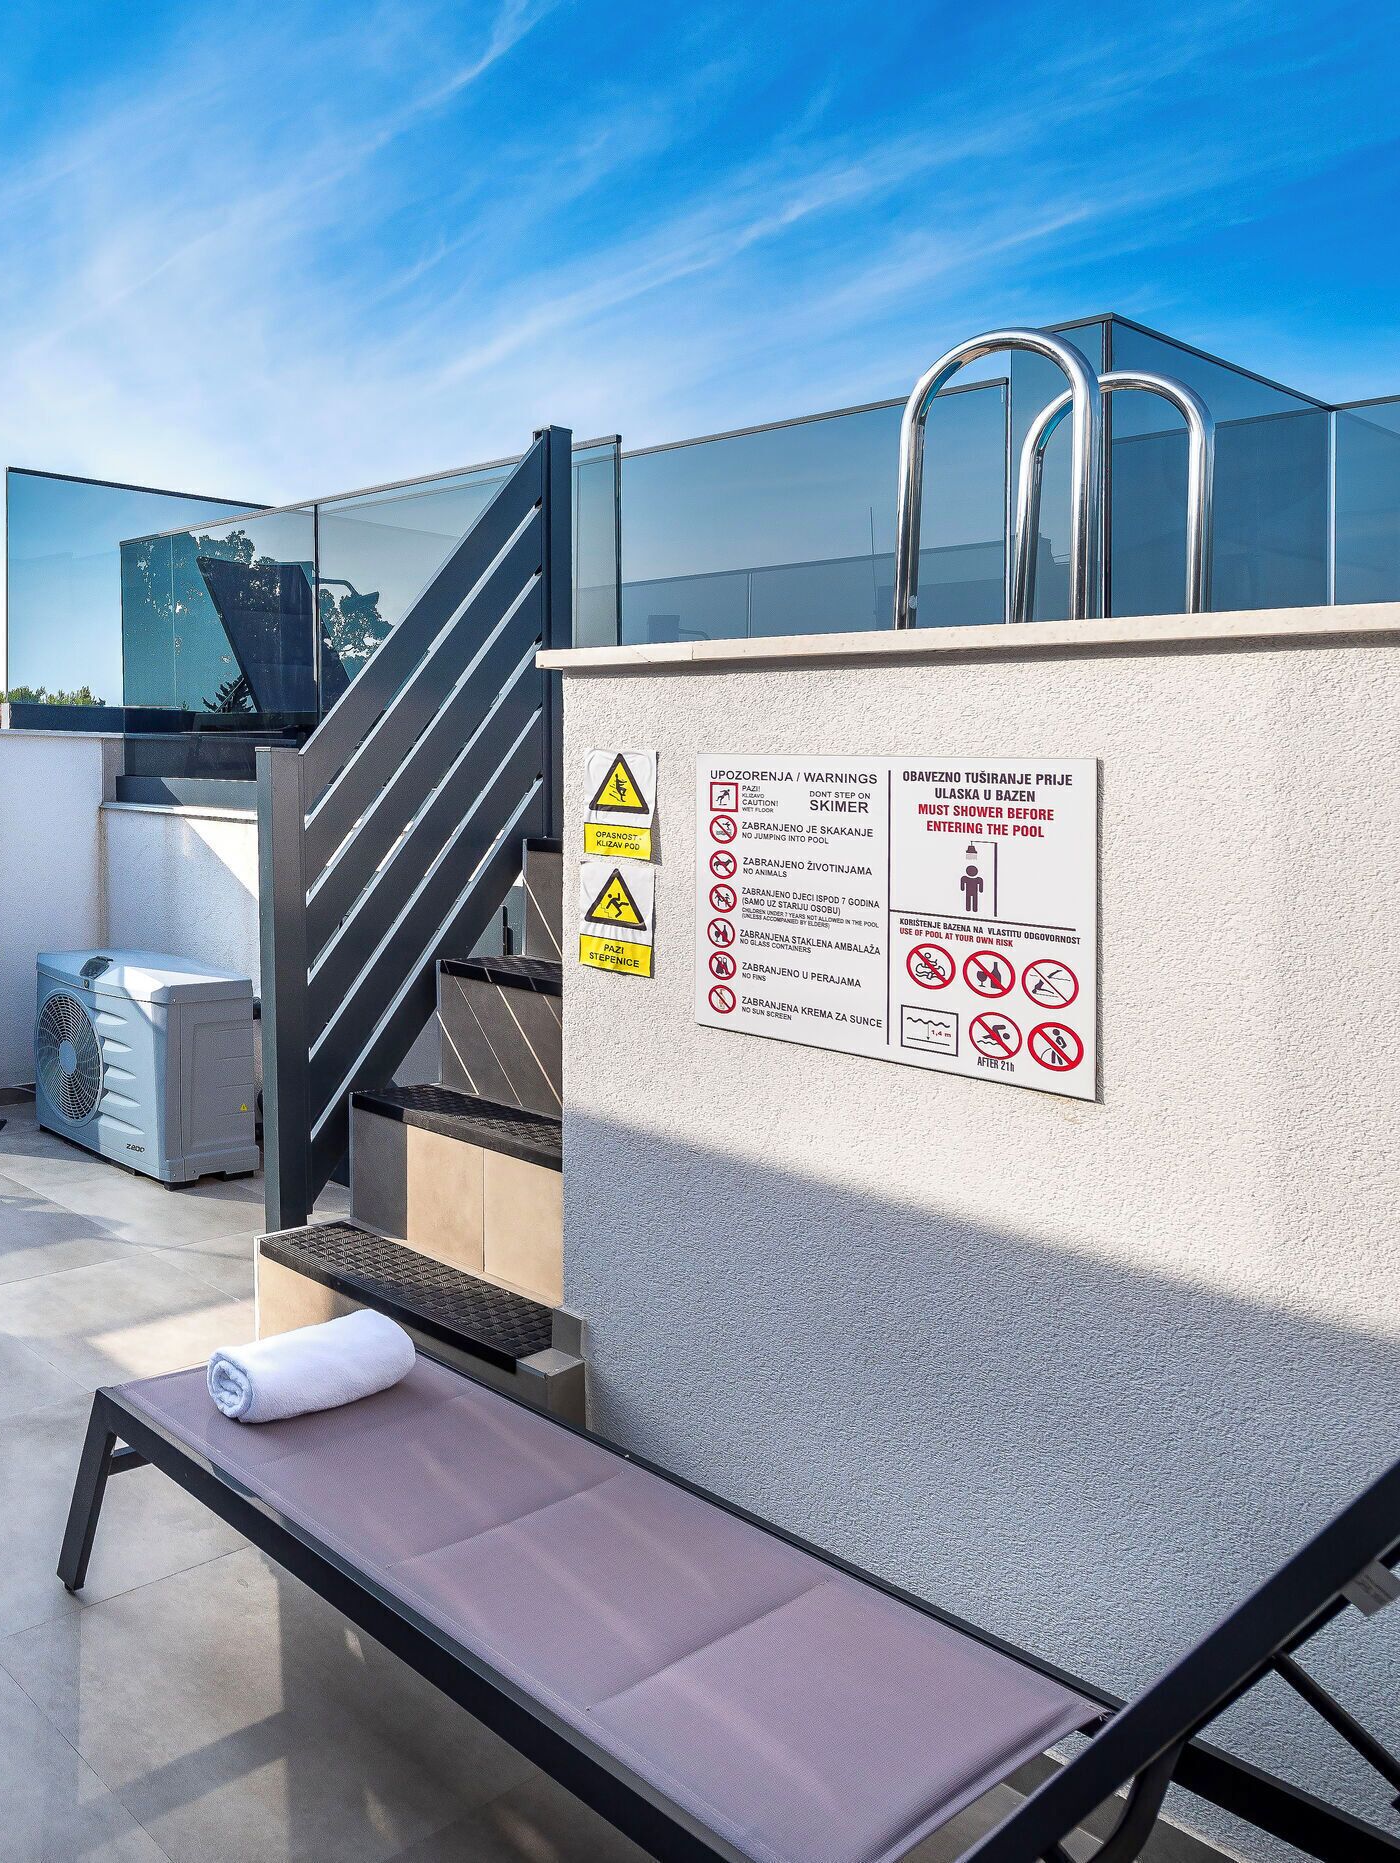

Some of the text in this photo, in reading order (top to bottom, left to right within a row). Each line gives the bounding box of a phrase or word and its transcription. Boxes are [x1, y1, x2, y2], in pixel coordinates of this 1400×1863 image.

[710, 771, 793, 782] UPOZORENJA
[804, 773, 878, 784] WARNINGS
[903, 771, 1073, 786] OBAVEZNO TUŠIRANJE PRIJE
[935, 788, 1036, 802] ULASKA U BAZEN
[810, 800, 869, 813] SKIMER
[918, 804, 1054, 821] MUST SHOWER BEFORE
[596, 831, 638, 840] OPASNOST
[742, 822, 803, 833] ZABRANJENO
[820, 826, 874, 837] SKAKANJE
[926, 821, 1045, 837] ENTERING THE POOL
[597, 840, 622, 848] KLIZAV
[743, 857, 872, 875] ZABRANJENO ŽIVOTINJAMA
[755, 869, 787, 877] ANIMALS
[742, 887, 790, 898] ZABRANJENO
[793, 892, 814, 901] DJECI
[816, 895, 839, 904] ISPOD
[848, 898, 880, 908] GODINA
[742, 898, 765, 906] (SAMO
[811, 904, 840, 916] OSOBU)
[763, 915, 798, 925] ACCOMPANIED
[900, 918, 1081, 945] KORIŠTENJE BAZENA NA VLASTITU ODGOVORNOST
[925, 930, 943, 939] POOL
[955, 934, 974, 943] YOUR
[976, 937, 994, 945] OWN
[996, 938, 1013, 947] RISK
[604, 944, 624, 954] PAZI
[740, 929, 880, 955] ZABRANJENA STAKLENA AMBALAŽA
[751, 940, 770, 948] GLASS
[772, 942, 811, 953] CONTAINERS
[589, 952, 639, 968] STEPENICE
[742, 962, 799, 978] ZABRANJENO
[811, 972, 861, 988] PERAJAMA
[742, 996, 882, 1028] ZABRANJENA KREMA ZA SUNCE
[752, 1008, 765, 1016] SUN
[767, 1010, 792, 1020] SCREEN
[977, 1057, 1014, 1072] AFTER 21h
